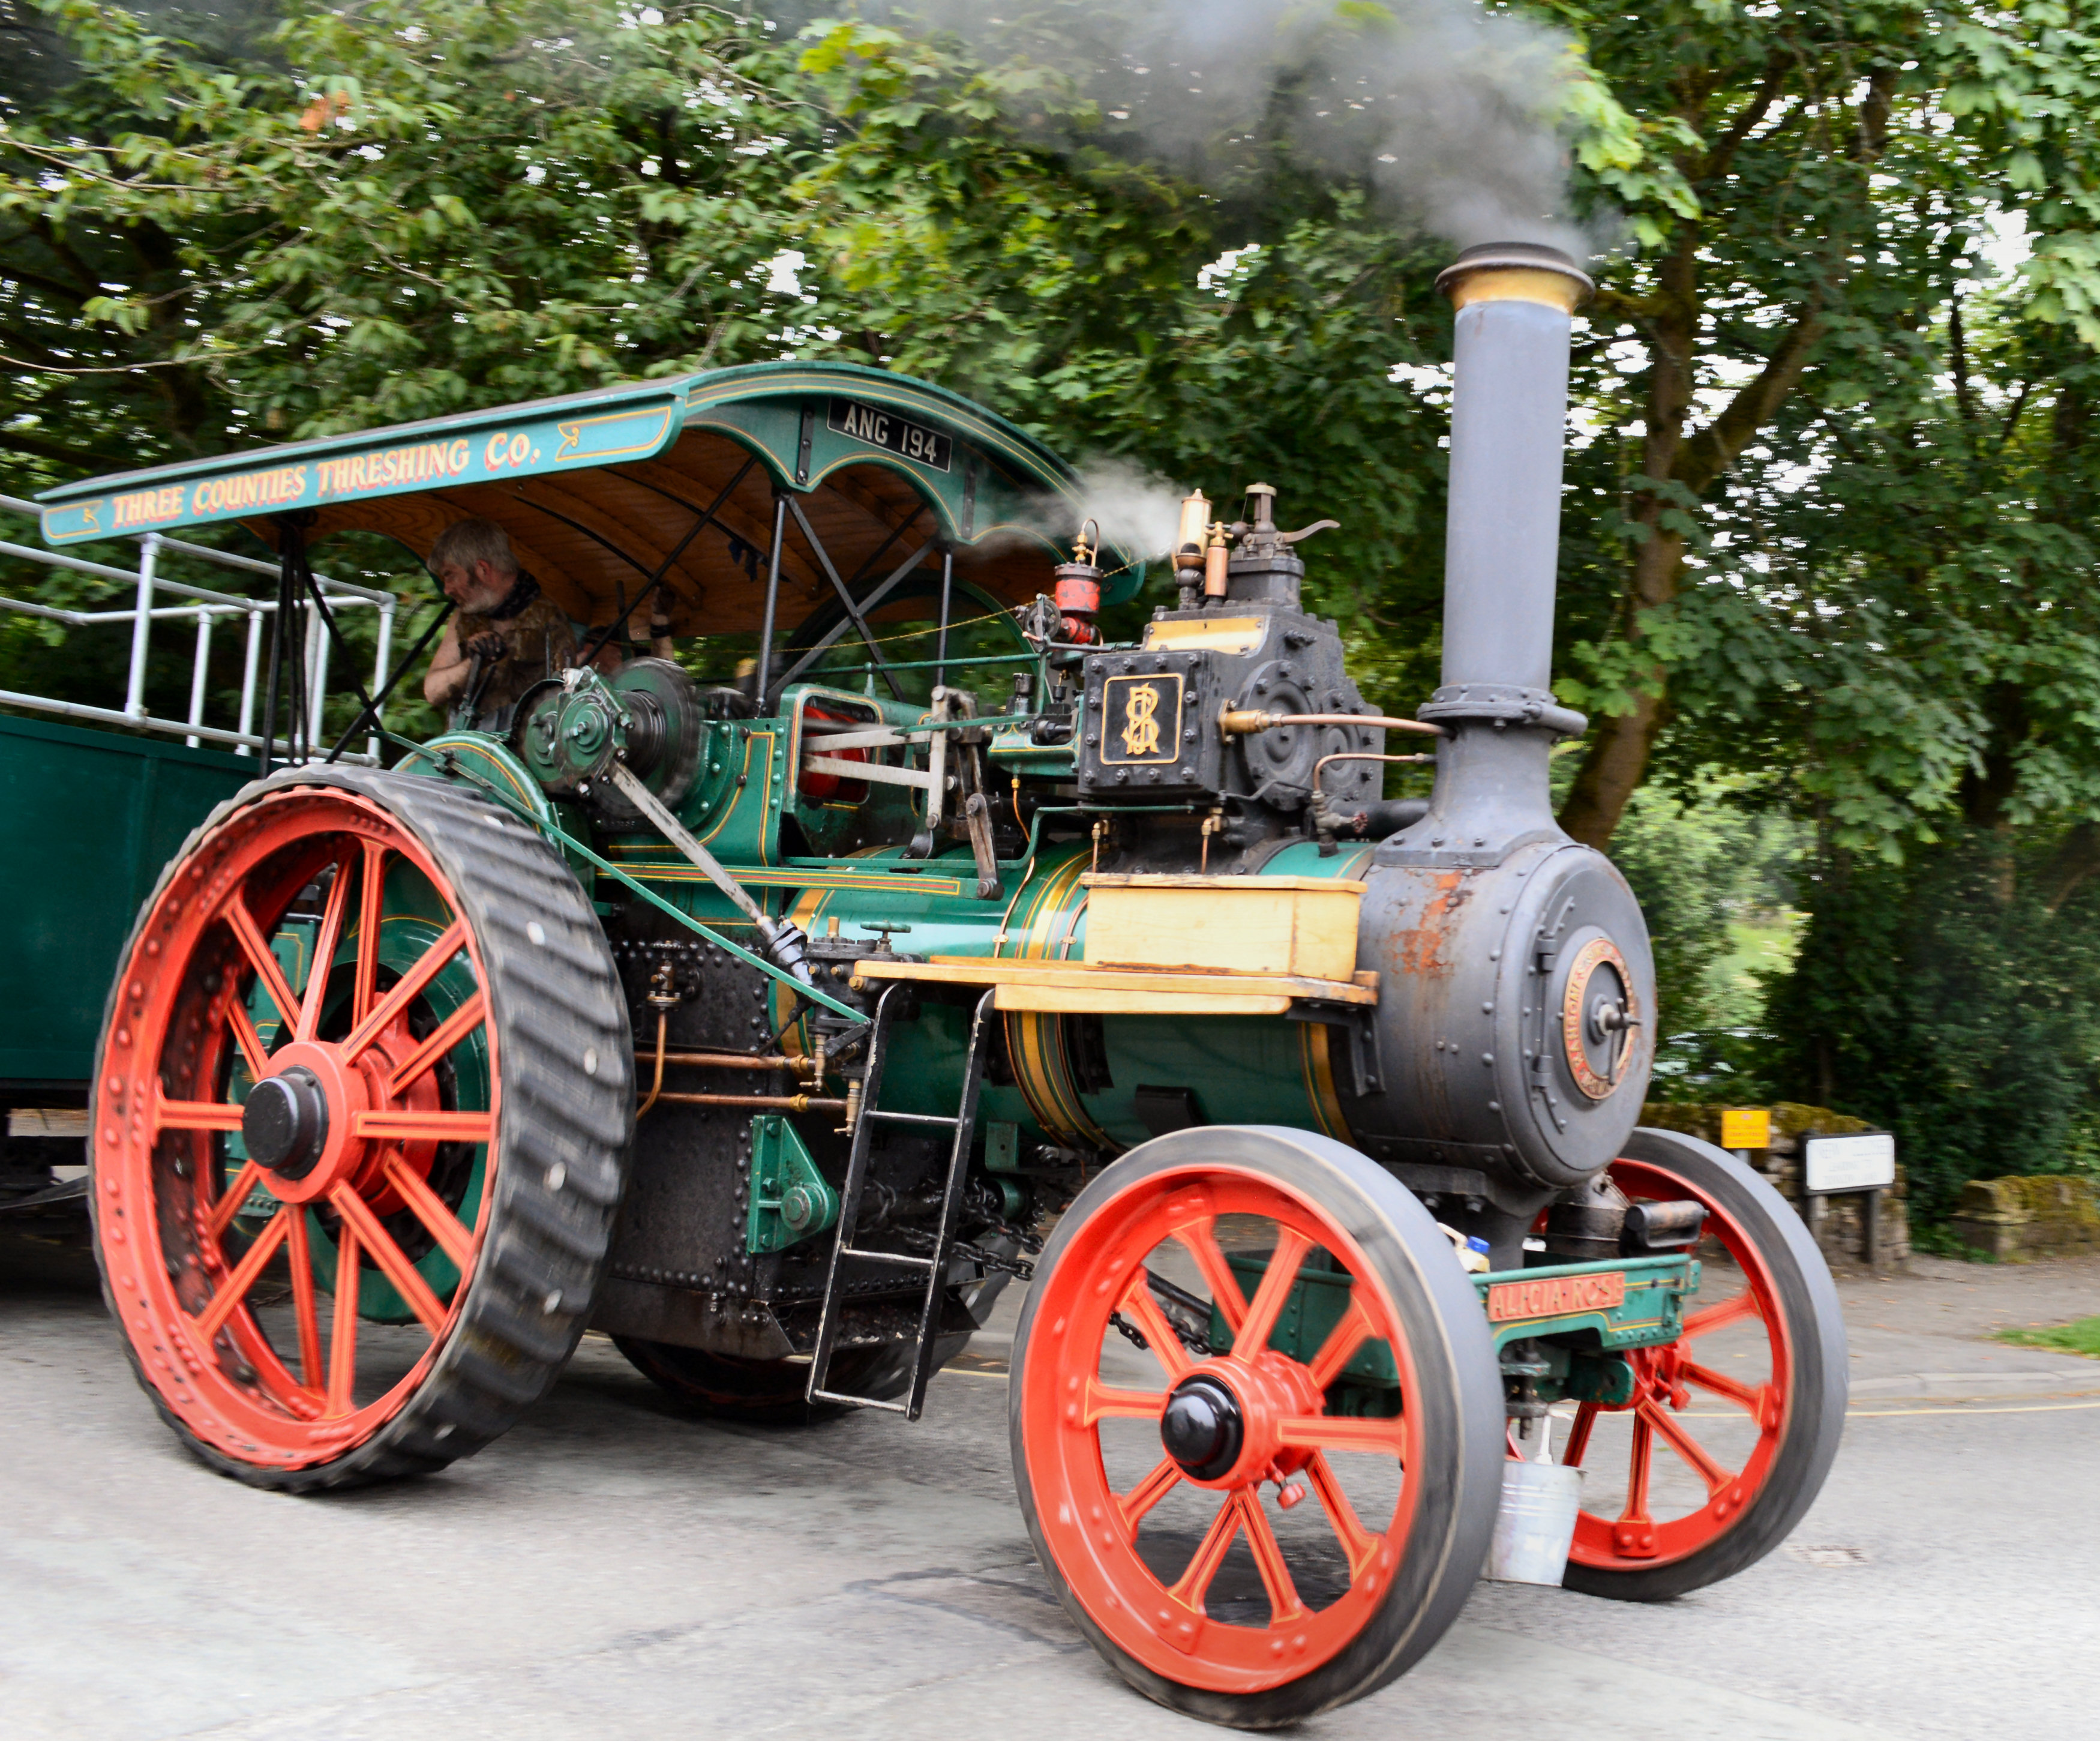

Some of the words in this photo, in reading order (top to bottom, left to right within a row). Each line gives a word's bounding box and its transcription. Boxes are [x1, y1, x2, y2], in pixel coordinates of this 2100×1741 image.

[844, 404, 889, 445] ANG
[902, 425, 937, 463] 194
[113, 486, 185, 528] THREE
[192, 466, 307, 516] COUNTIES
[316, 439, 470, 497] THRESHING
[1493, 1280, 1562, 1317] ALICIA
[1573, 1273, 1624, 1309] ROSE
